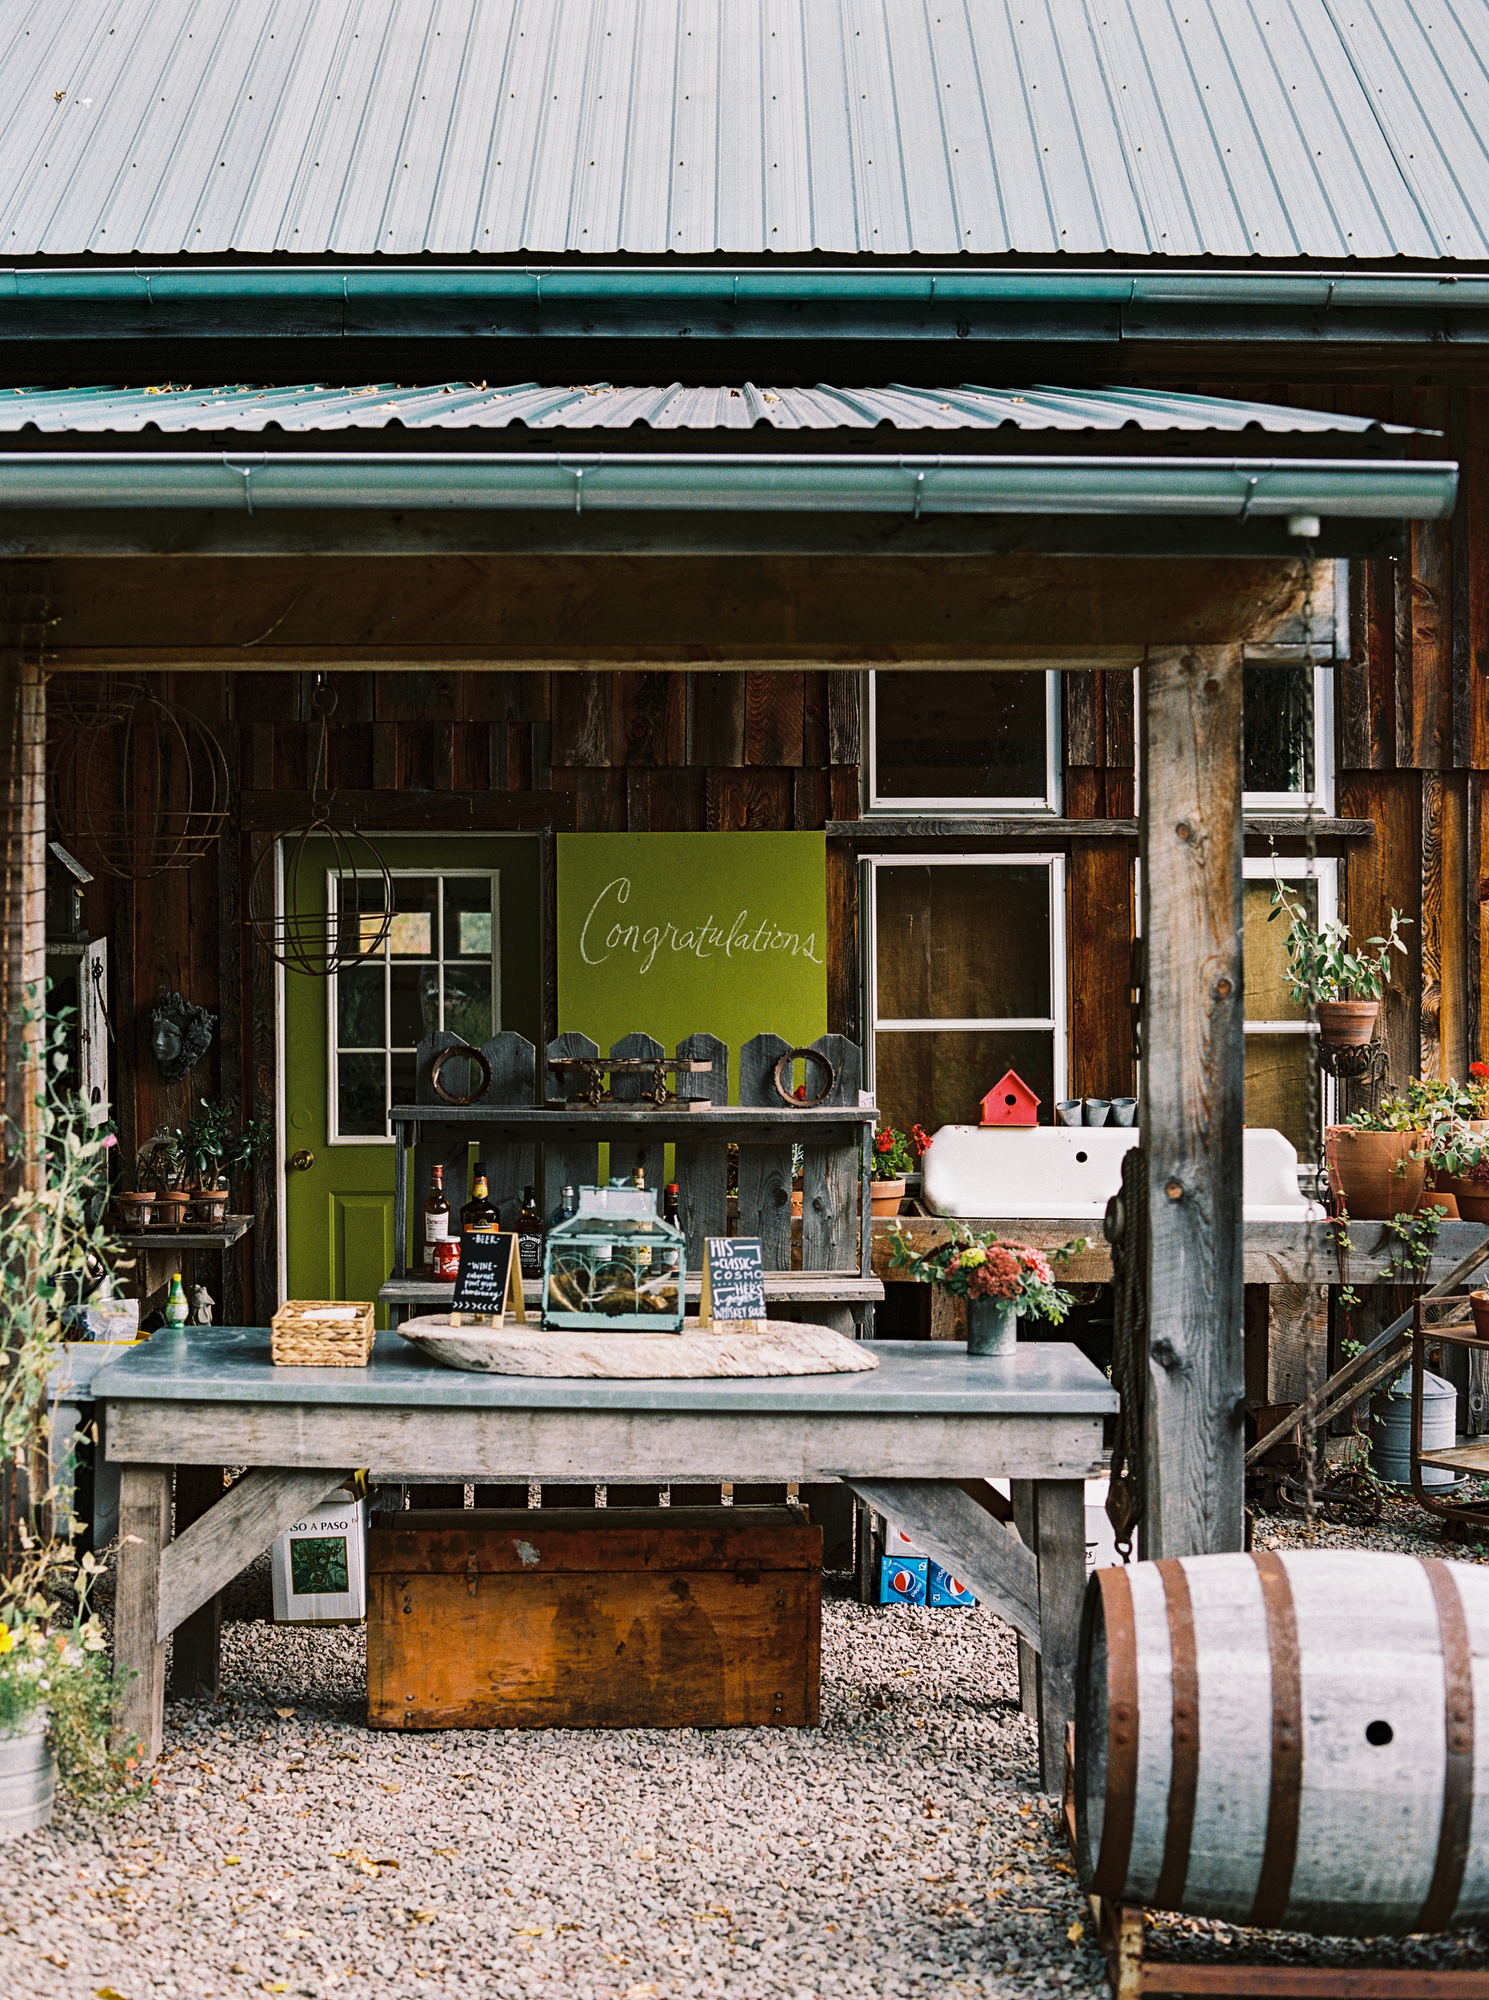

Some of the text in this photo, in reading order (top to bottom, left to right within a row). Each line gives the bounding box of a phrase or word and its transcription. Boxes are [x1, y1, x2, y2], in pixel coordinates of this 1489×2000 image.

[580, 877, 823, 974] Congratulations
[710, 1240, 734, 1258] HIS
[719, 1257, 753, 1270] CLASSIC
[713, 1270, 764, 1280] COSMO
[735, 1283, 764, 1296] HERS
[713, 1306, 767, 1320] WHISKEY SOUR
[290, 1521, 348, 1531] SO A PASO
[936, 1569, 946, 1583] epsi
[910, 1582, 922, 1597] pepsi
